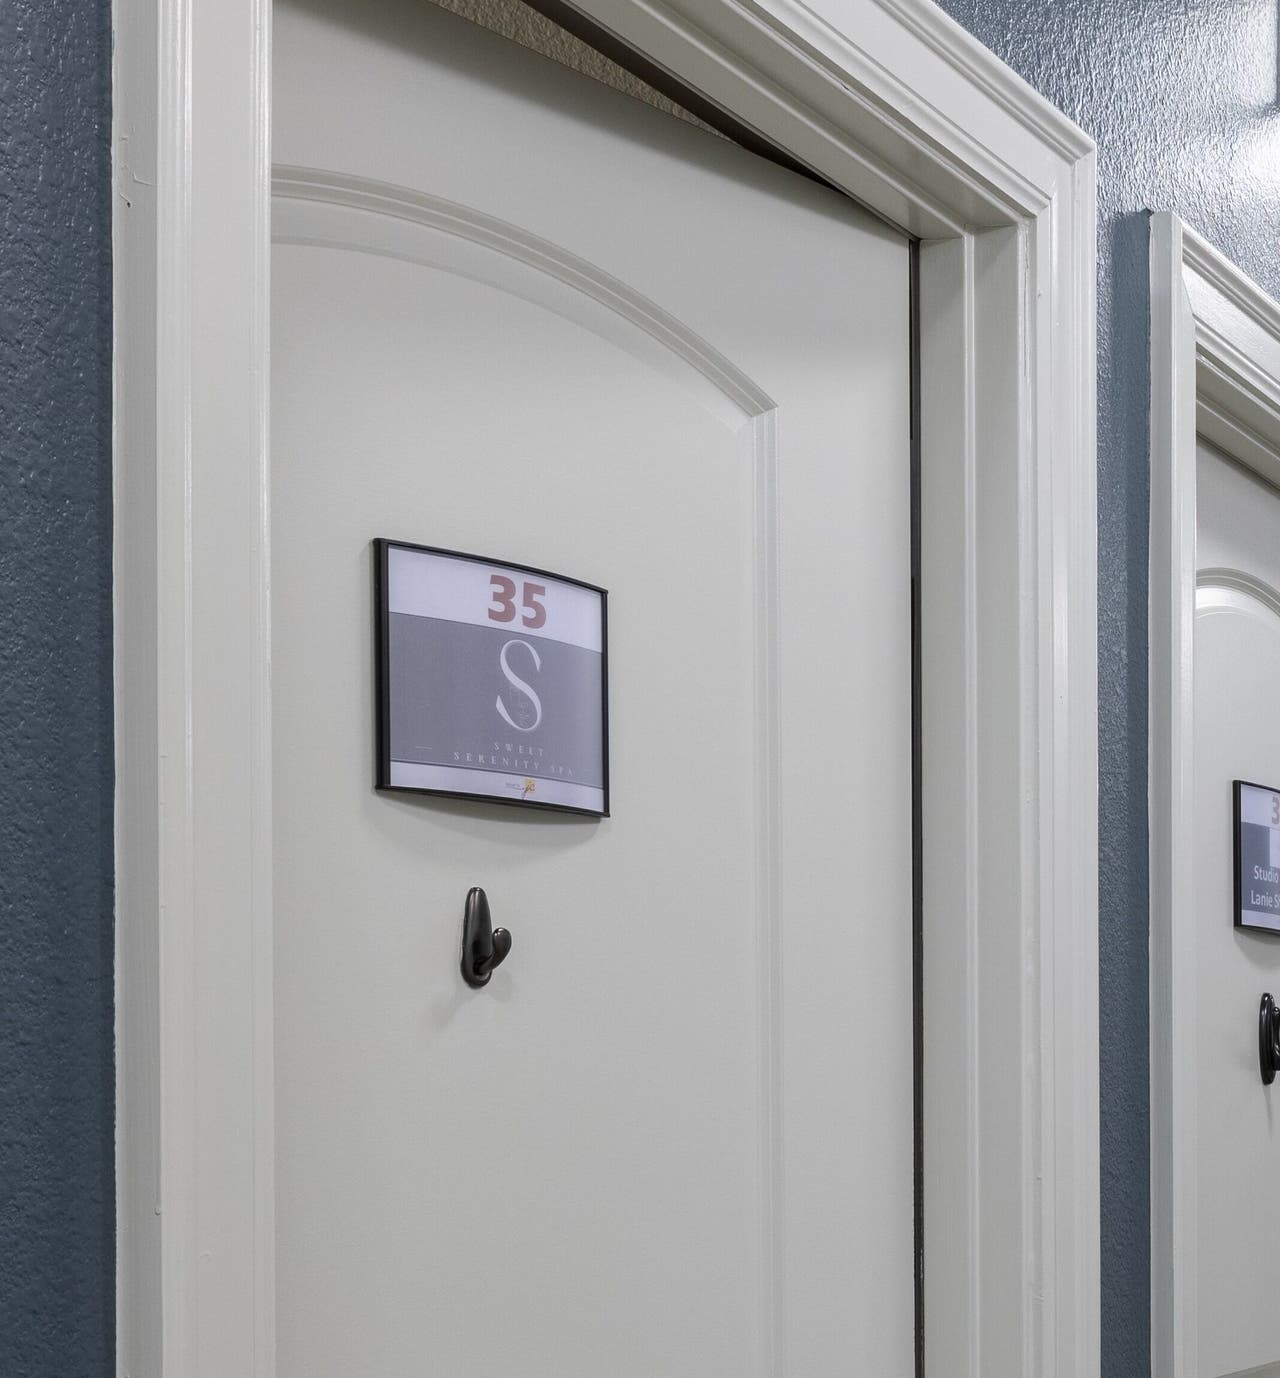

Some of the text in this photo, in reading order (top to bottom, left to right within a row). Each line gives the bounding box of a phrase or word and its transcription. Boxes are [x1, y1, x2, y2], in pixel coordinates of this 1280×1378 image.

[487, 573, 547, 630] 35
[495, 639, 542, 732] S
[453, 751, 541, 769] SERENITY
[1253, 864, 1279, 884] Studio
[1251, 889, 1273, 908] Lanie
